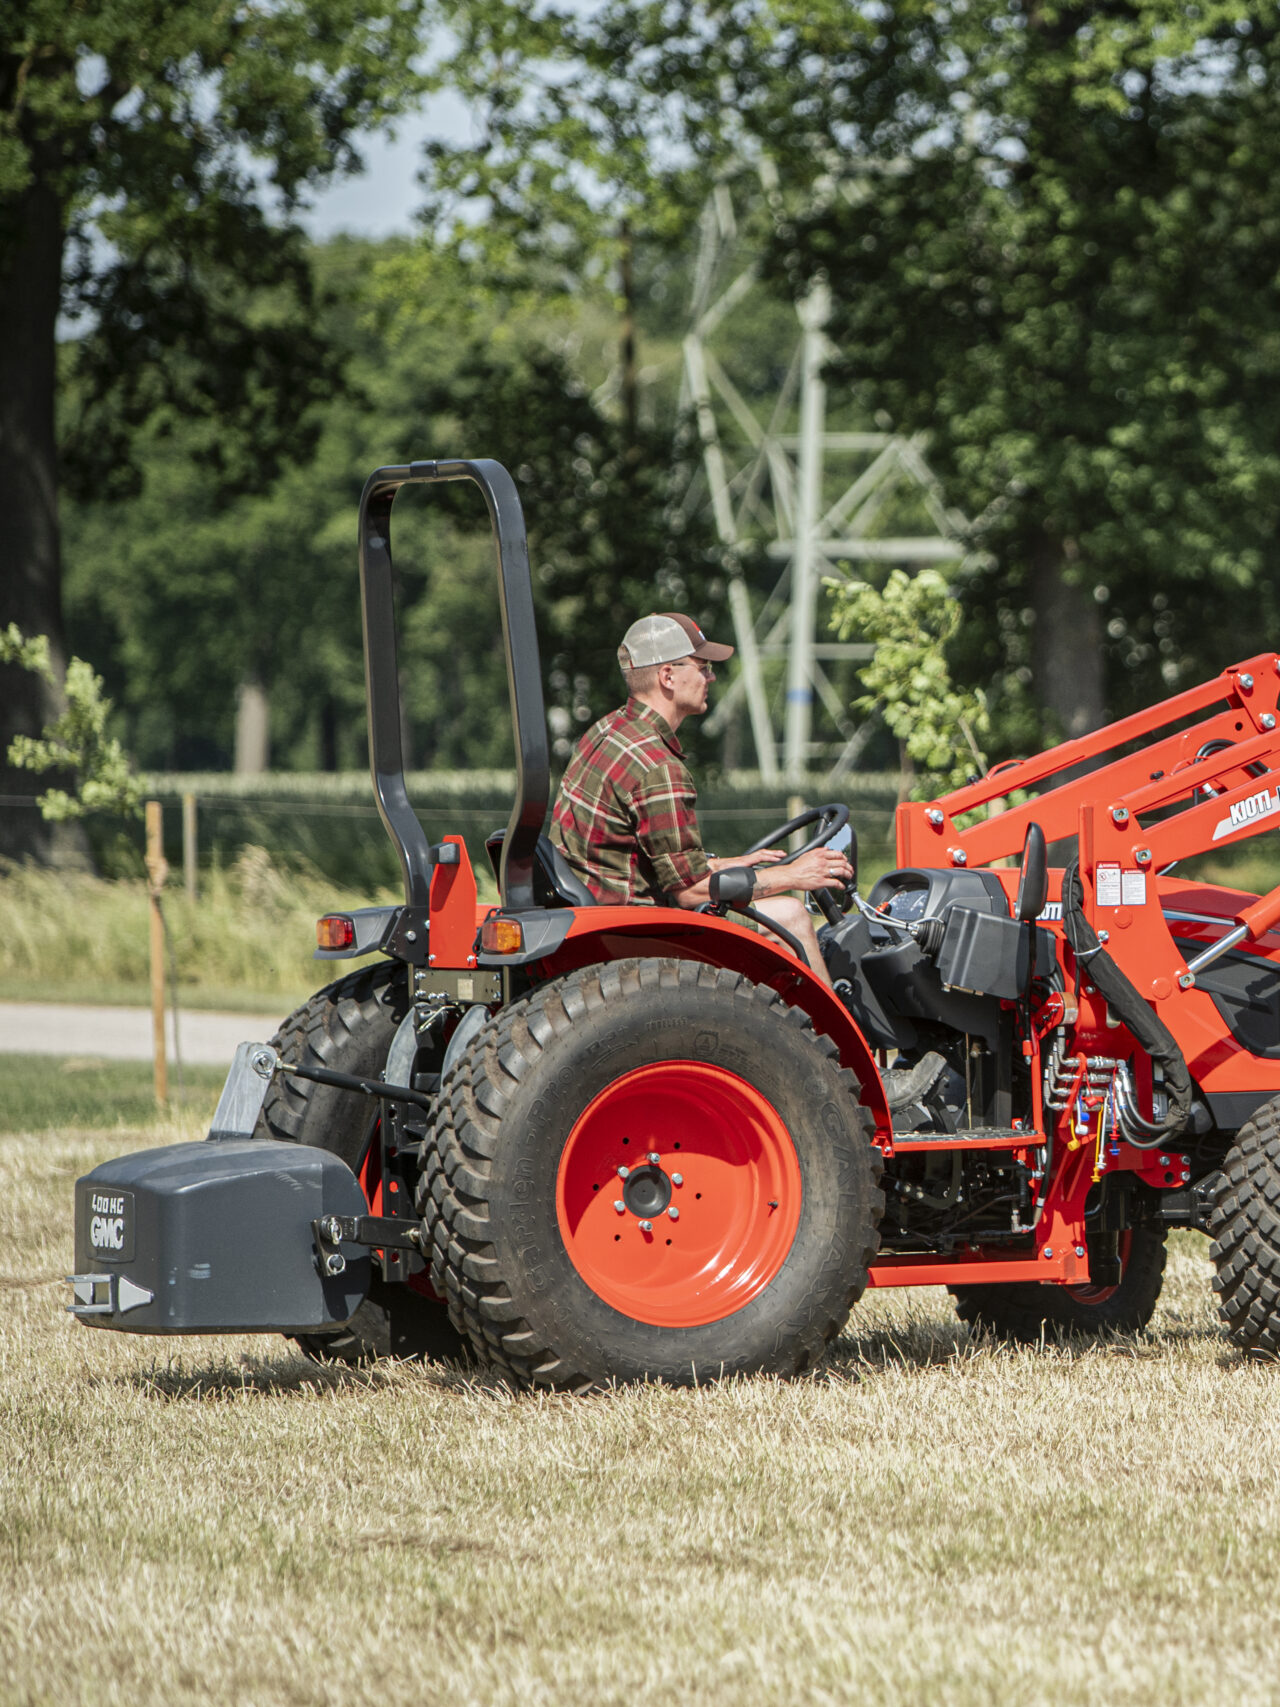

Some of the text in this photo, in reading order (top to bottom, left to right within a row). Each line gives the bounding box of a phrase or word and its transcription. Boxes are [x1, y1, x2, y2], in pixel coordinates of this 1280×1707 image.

[1229, 788, 1273, 826] KIOTI
[93, 1194, 109, 1213] 400
[91, 1216, 124, 1250] GMC
